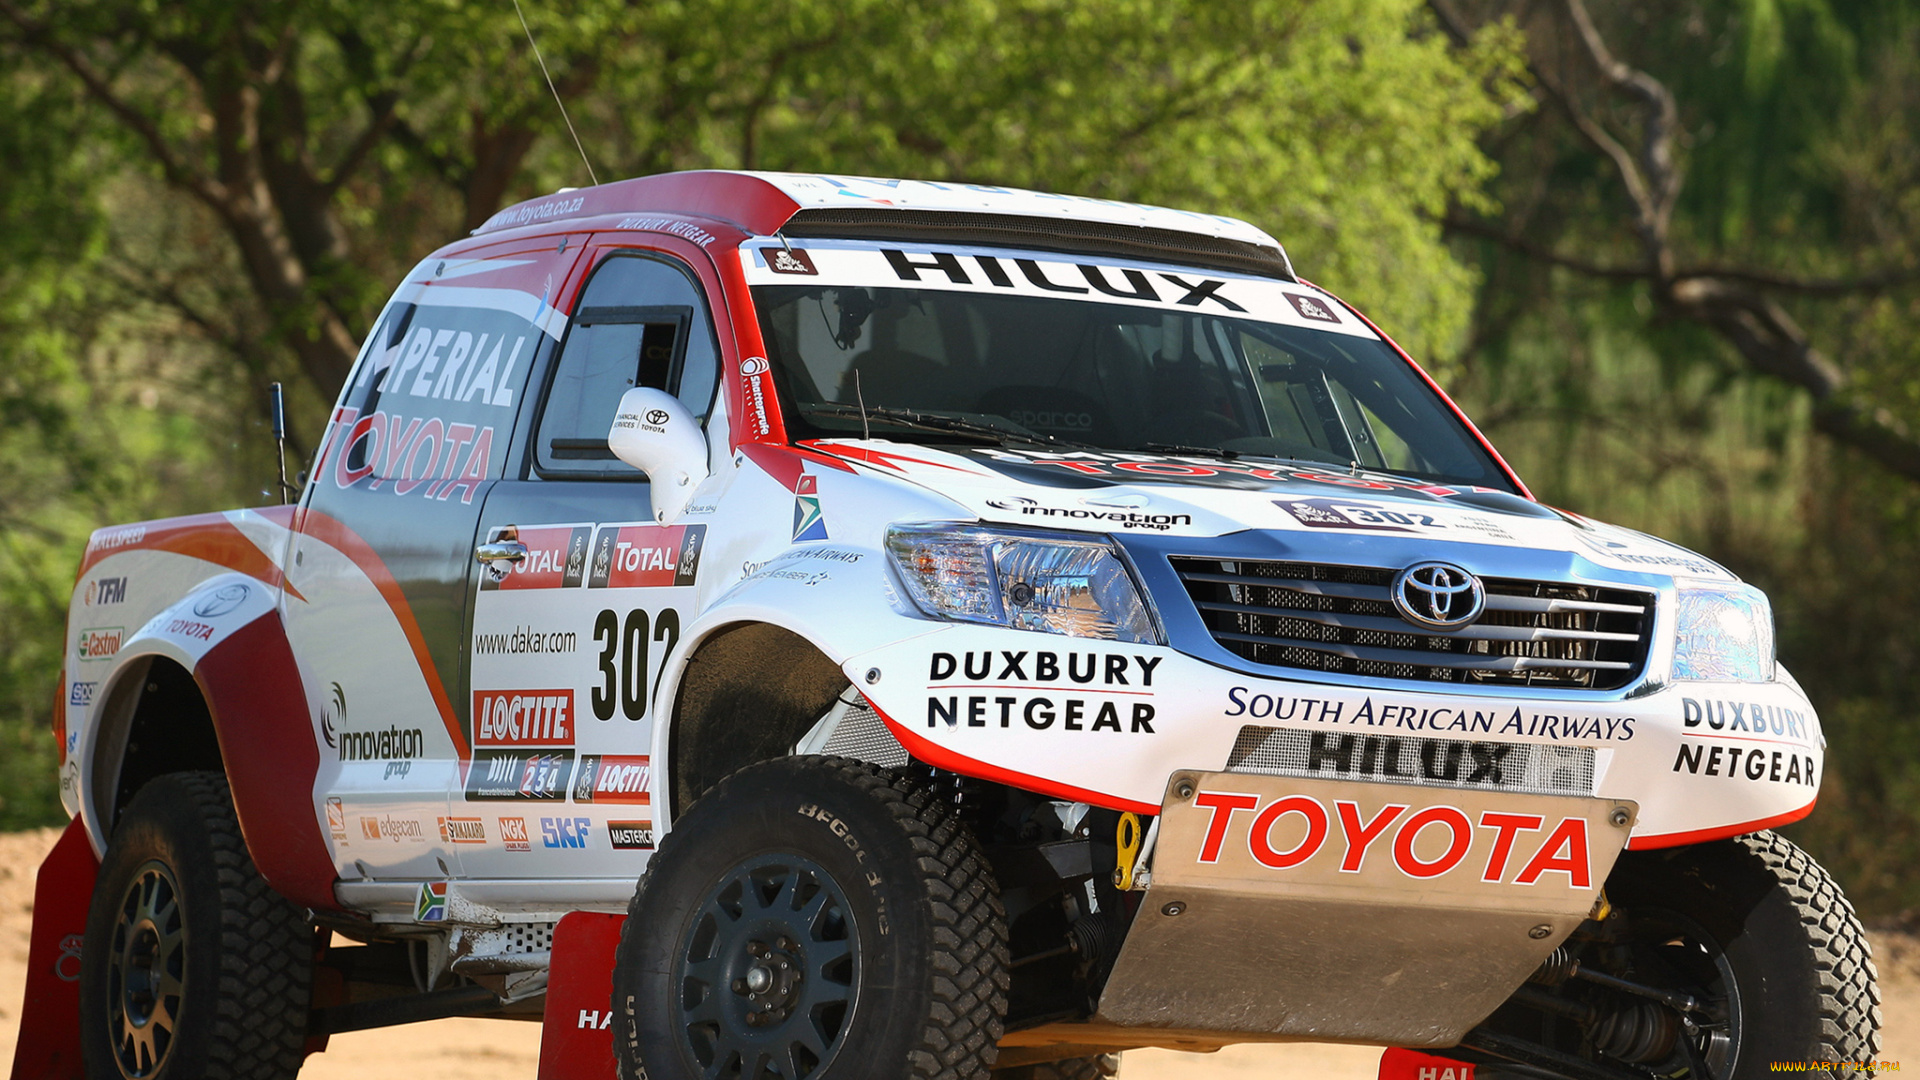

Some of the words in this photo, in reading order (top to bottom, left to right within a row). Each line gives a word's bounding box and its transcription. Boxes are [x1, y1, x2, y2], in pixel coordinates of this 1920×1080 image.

[490, 197, 584, 226] www.toyota.co.za
[616, 218, 669, 230] DUXBURY
[667, 220, 716, 248] NETGEAR
[880, 249, 1249, 313] HILUX
[750, 375, 770, 435] Shatterprufe
[641, 424, 665, 434] TOYOTA
[312, 405, 494, 505] TOYOTA
[1022, 507, 1191, 526] innovation
[1124, 522, 1170, 531] group
[1347, 509, 1447, 528] 302
[510, 549, 563, 574] OTAL
[617, 542, 675, 572] TOTAL
[98, 577, 127, 604] TFM
[88, 632, 121, 657] Castrol
[165, 619, 215, 641] TOYOTA
[475, 625, 576, 654] www.dakar.com
[930, 651, 1163, 686] DUXBURY
[480, 694, 568, 741] LOCTITE
[928, 696, 1156, 734] NETGEAR
[1225, 686, 1342, 724] SOUTH
[1355, 696, 1493, 734] AFRICAN
[1499, 706, 1636, 742] AIRWAYS
[1682, 697, 1808, 740] DUXBURY
[339, 724, 423, 762] innovation
[1309, 732, 1511, 784] HILUX
[383, 761, 411, 781] group
[1673, 743, 1815, 787] NETGEAR
[380, 814, 422, 842] edgecam
[500, 818, 527, 840] NGK
[540, 817, 591, 848] SKF
[1193, 790, 1593, 890] TOYOTA
